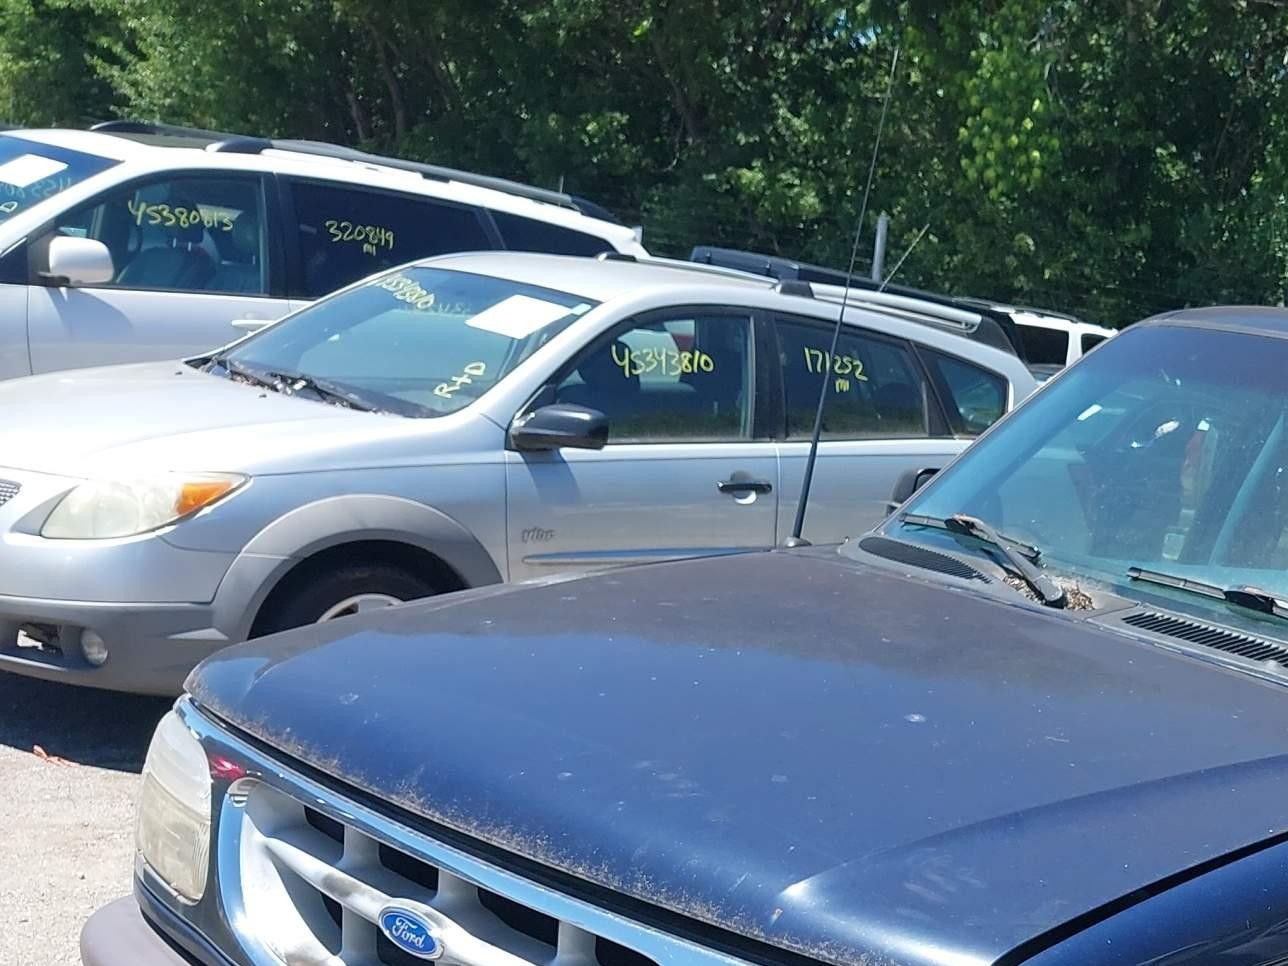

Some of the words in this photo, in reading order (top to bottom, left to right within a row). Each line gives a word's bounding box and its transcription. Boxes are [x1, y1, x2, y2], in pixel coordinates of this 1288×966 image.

[325, 220, 394, 249] 320849
[611, 344, 714, 378] 45343810
[804, 347, 869, 381] 171252
[392, 916, 426, 949] Ford
